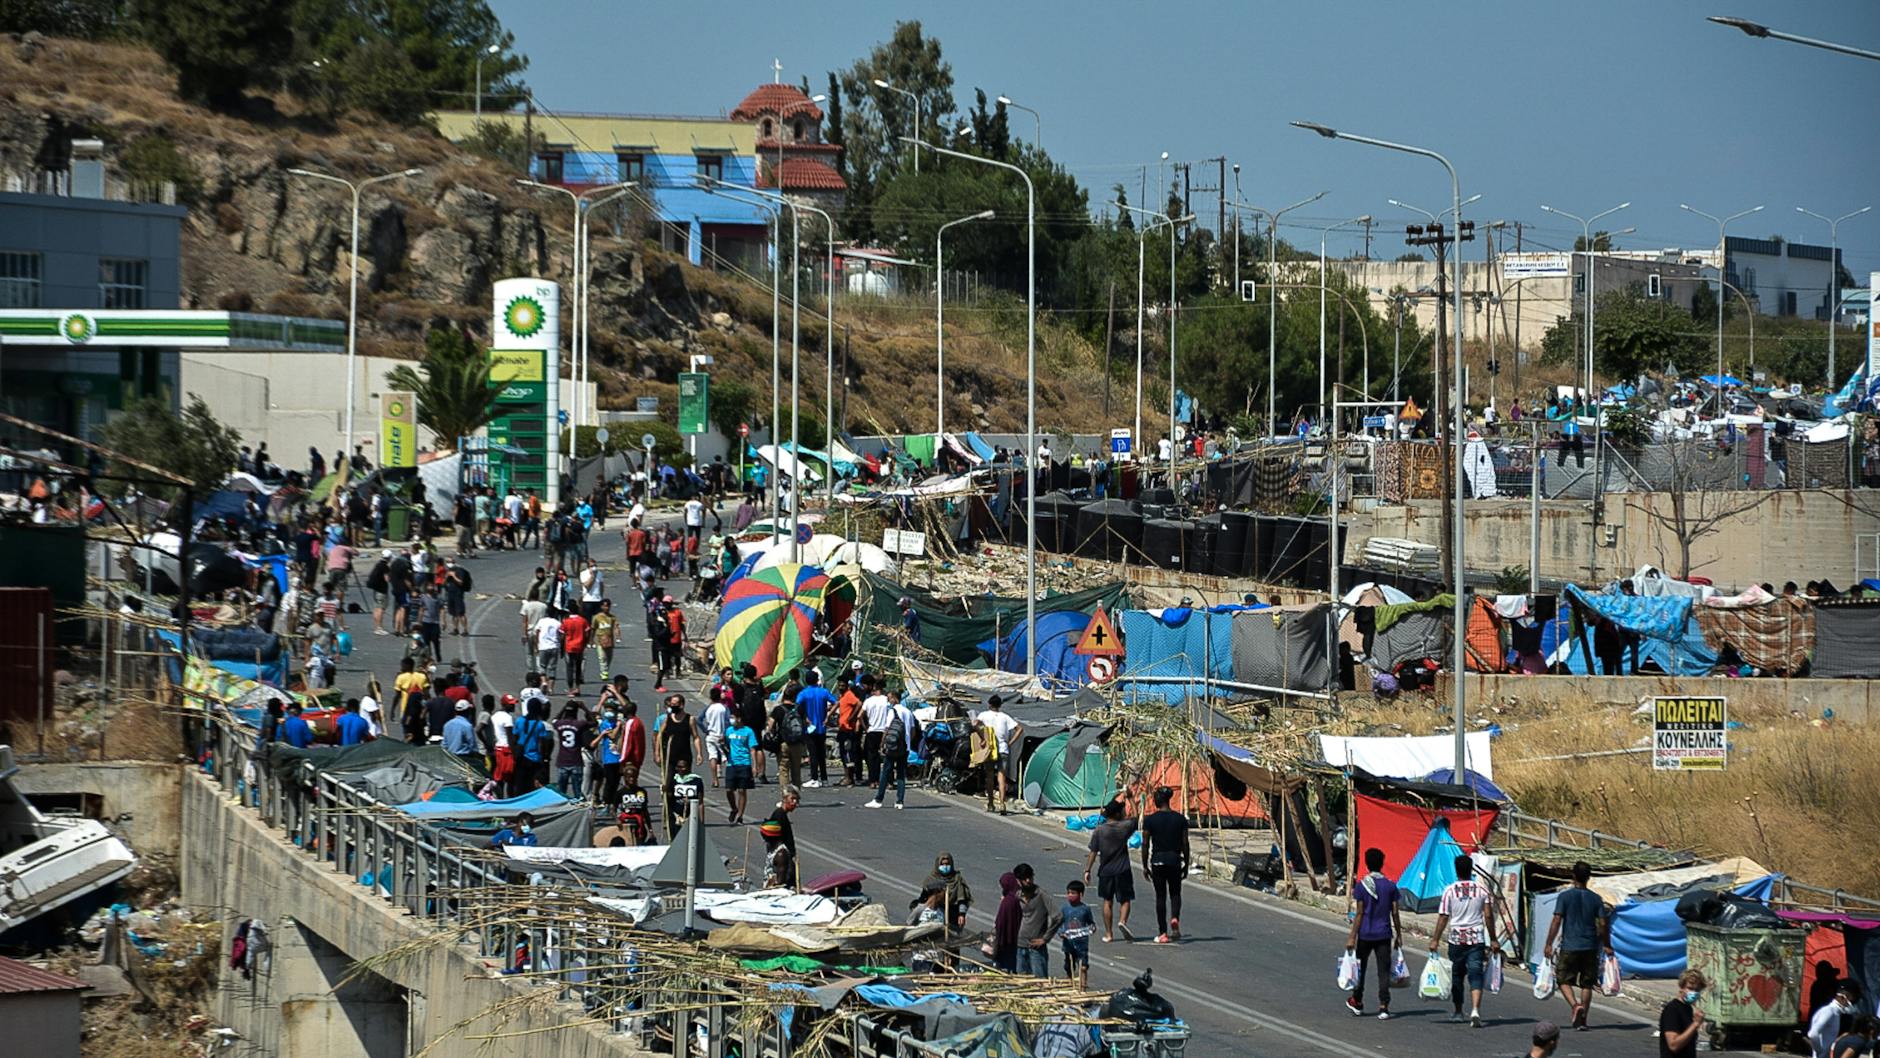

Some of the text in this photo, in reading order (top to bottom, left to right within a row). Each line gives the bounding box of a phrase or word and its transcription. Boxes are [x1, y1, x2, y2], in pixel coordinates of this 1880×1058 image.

[1657, 701, 1722, 722] ΠΩΛΕΙΤΑΙ
[562, 730, 576, 748] 3
[1657, 732, 1723, 749] ΚΟΥΝΕΛΛΗΣ
[622, 793, 646, 804] D&G
